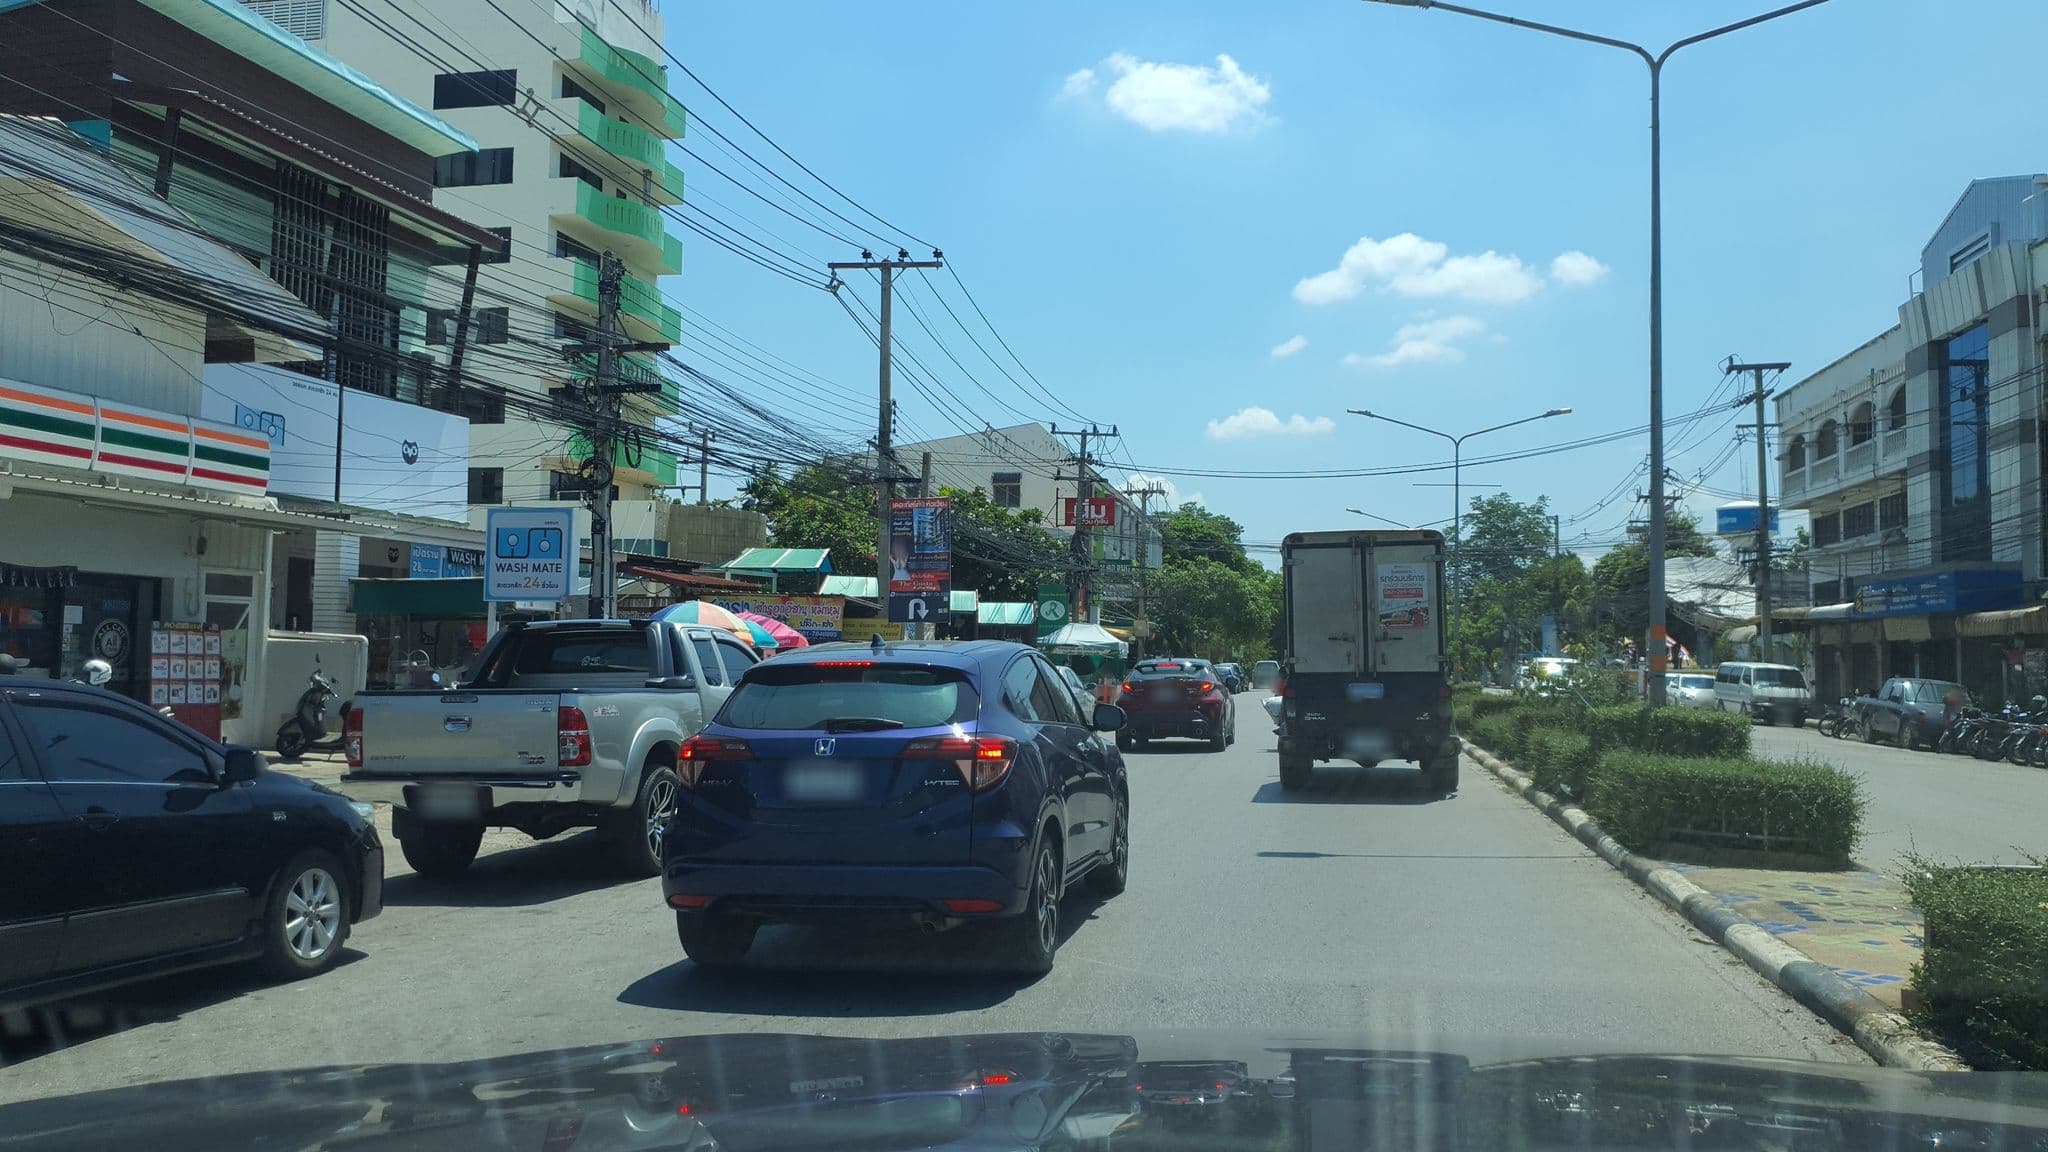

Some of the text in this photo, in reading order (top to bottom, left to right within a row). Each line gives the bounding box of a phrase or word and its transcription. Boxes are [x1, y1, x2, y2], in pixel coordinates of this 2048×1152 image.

[451, 550, 477, 566] WASH
[496, 563, 562, 573] WASH MATE
[523, 576, 540, 588] 24
